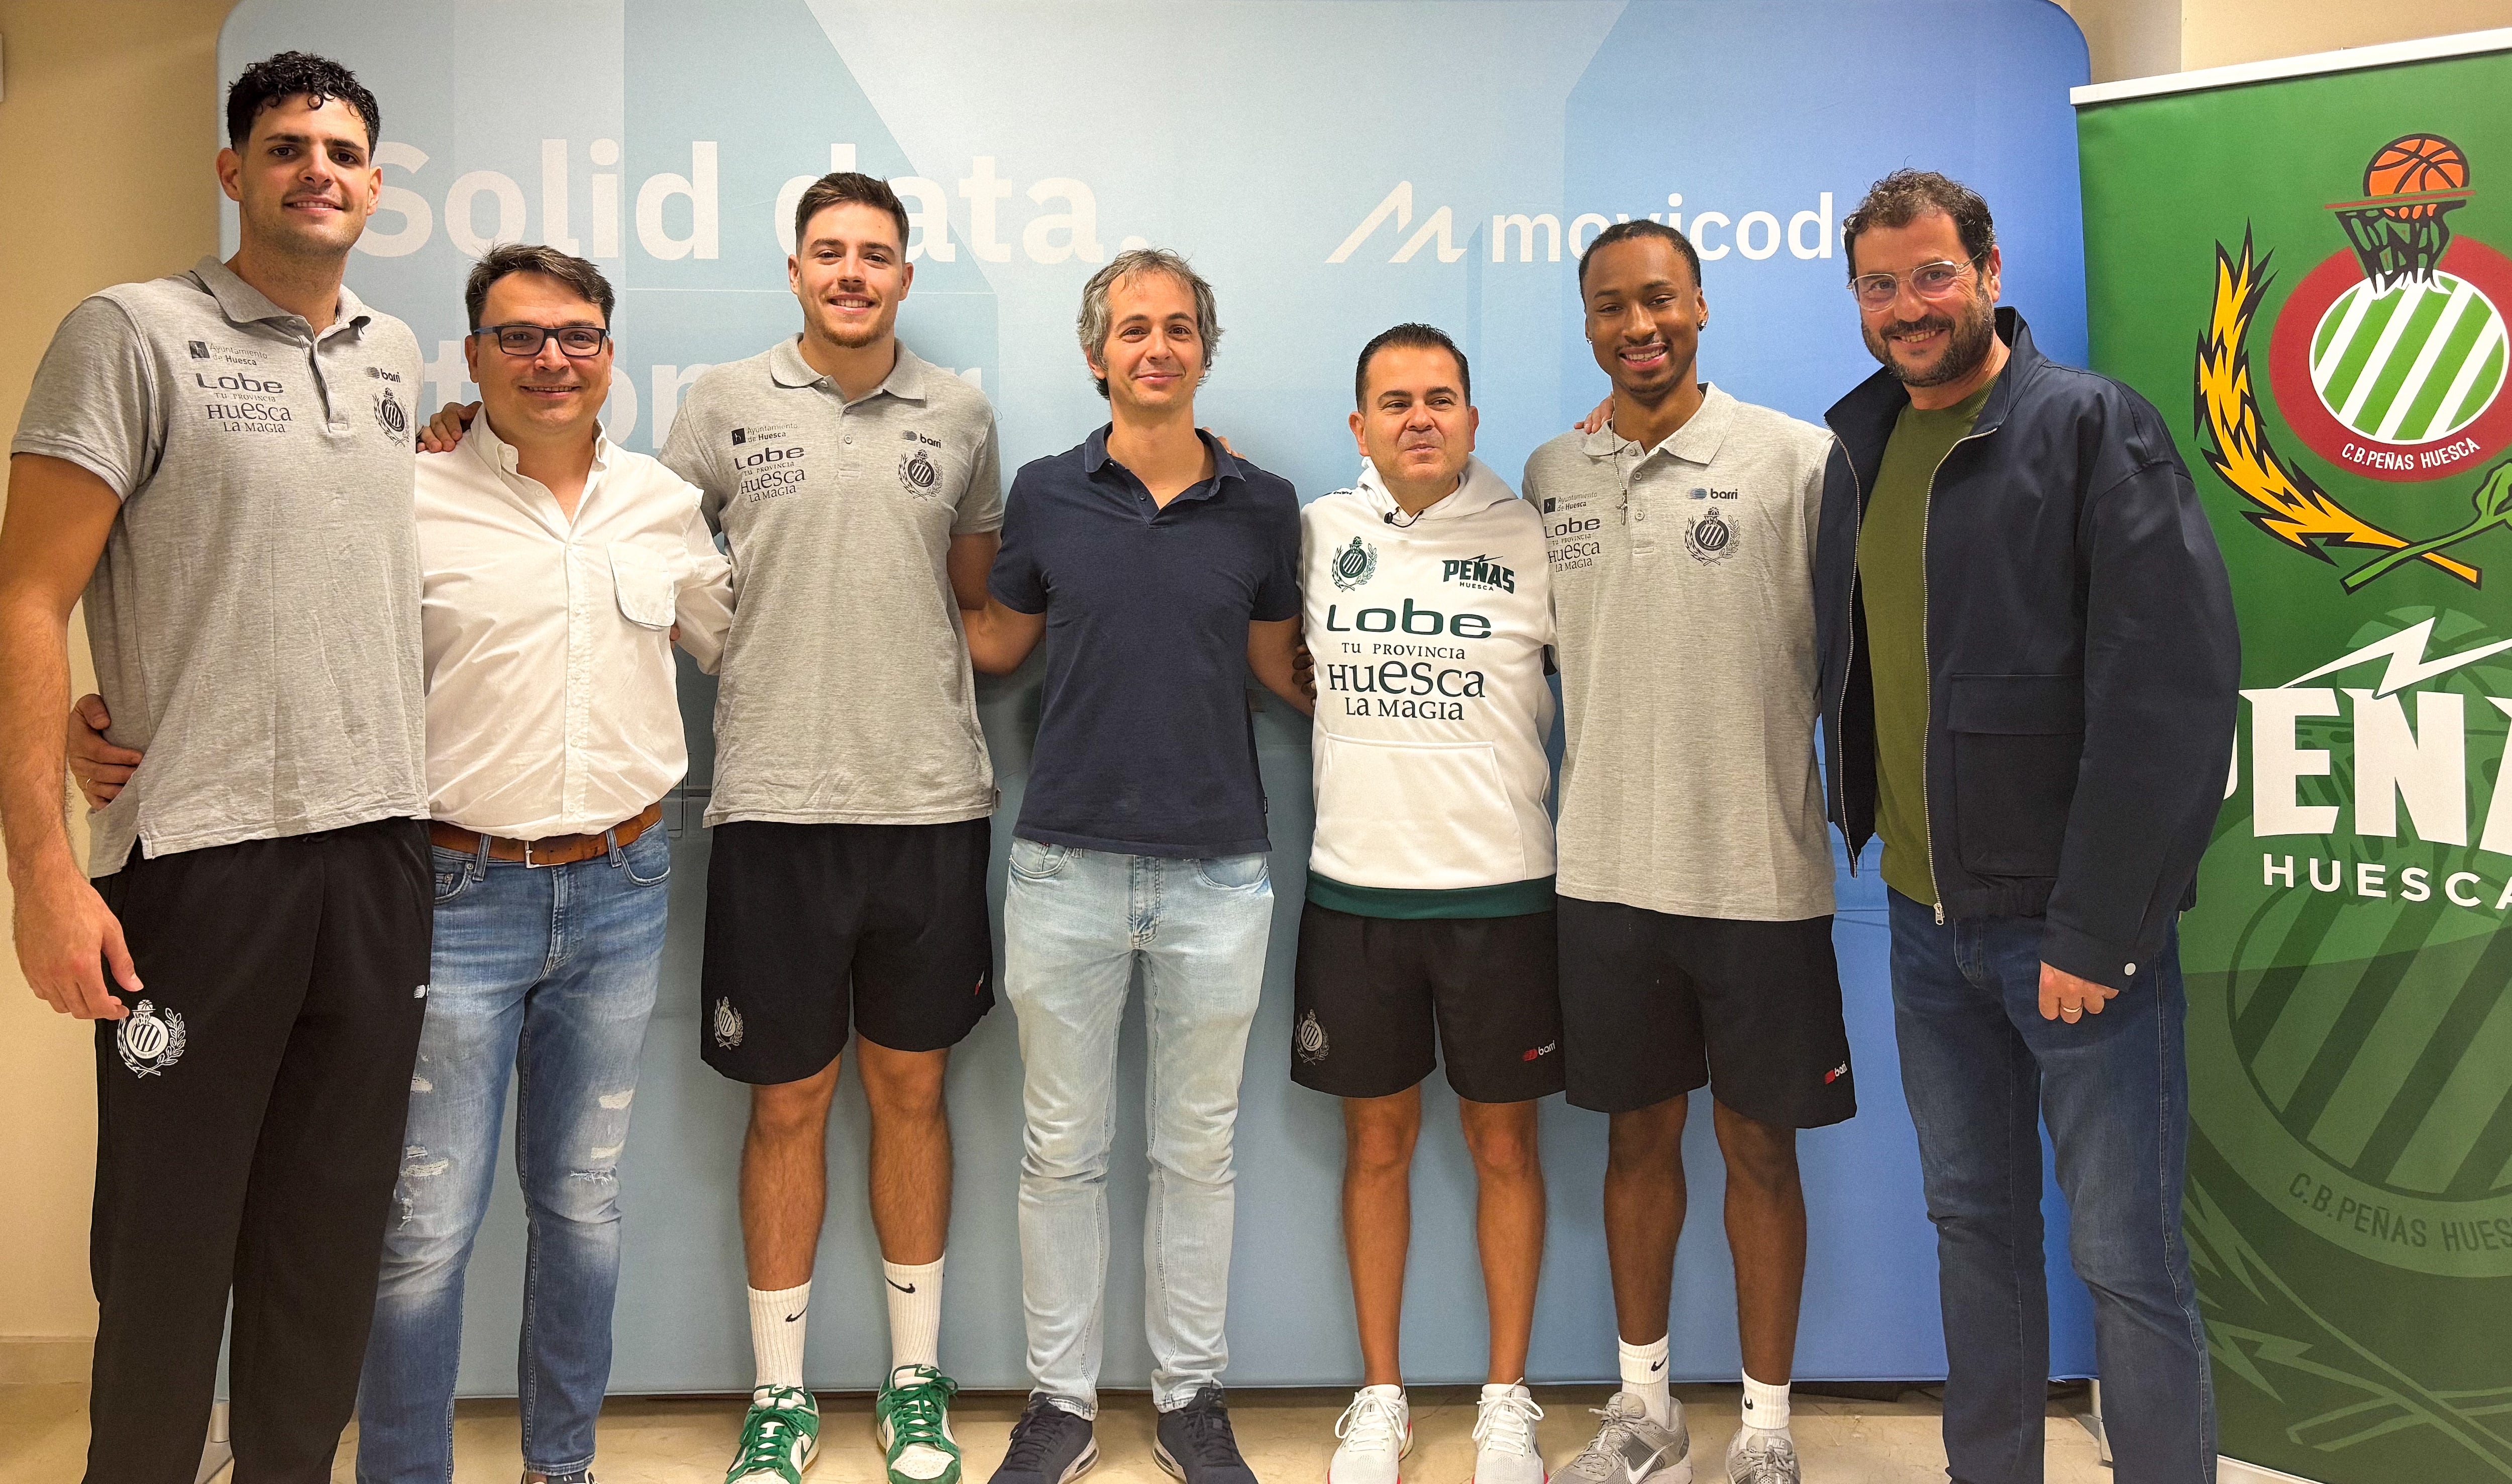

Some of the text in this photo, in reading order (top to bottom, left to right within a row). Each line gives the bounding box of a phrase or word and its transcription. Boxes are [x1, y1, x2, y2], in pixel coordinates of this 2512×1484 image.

[351, 139, 719, 260] Solid
[1492, 191, 1847, 262] moicod
[210, 343, 268, 359] Ayuntamiento
[226, 355, 257, 365] Huesca
[196, 373, 284, 393] Lobe
[380, 368, 400, 383] barri
[747, 423, 798, 435] Ayuntamiento
[758, 432, 786, 441] Huesca
[920, 434, 941, 449] barri
[734, 447, 804, 470] Lobe
[2420, 437, 2480, 469] HUESCA
[1710, 488, 1738, 499] barri
[1565, 501, 1587, 510] Huesca
[1544, 517, 1600, 539] Lobe
[1459, 582, 1494, 591] HUESCA
[1327, 598, 1491, 639] Lobe
[1327, 661, 1485, 698] Huesca
[1538, 1039, 1556, 1055] barri
